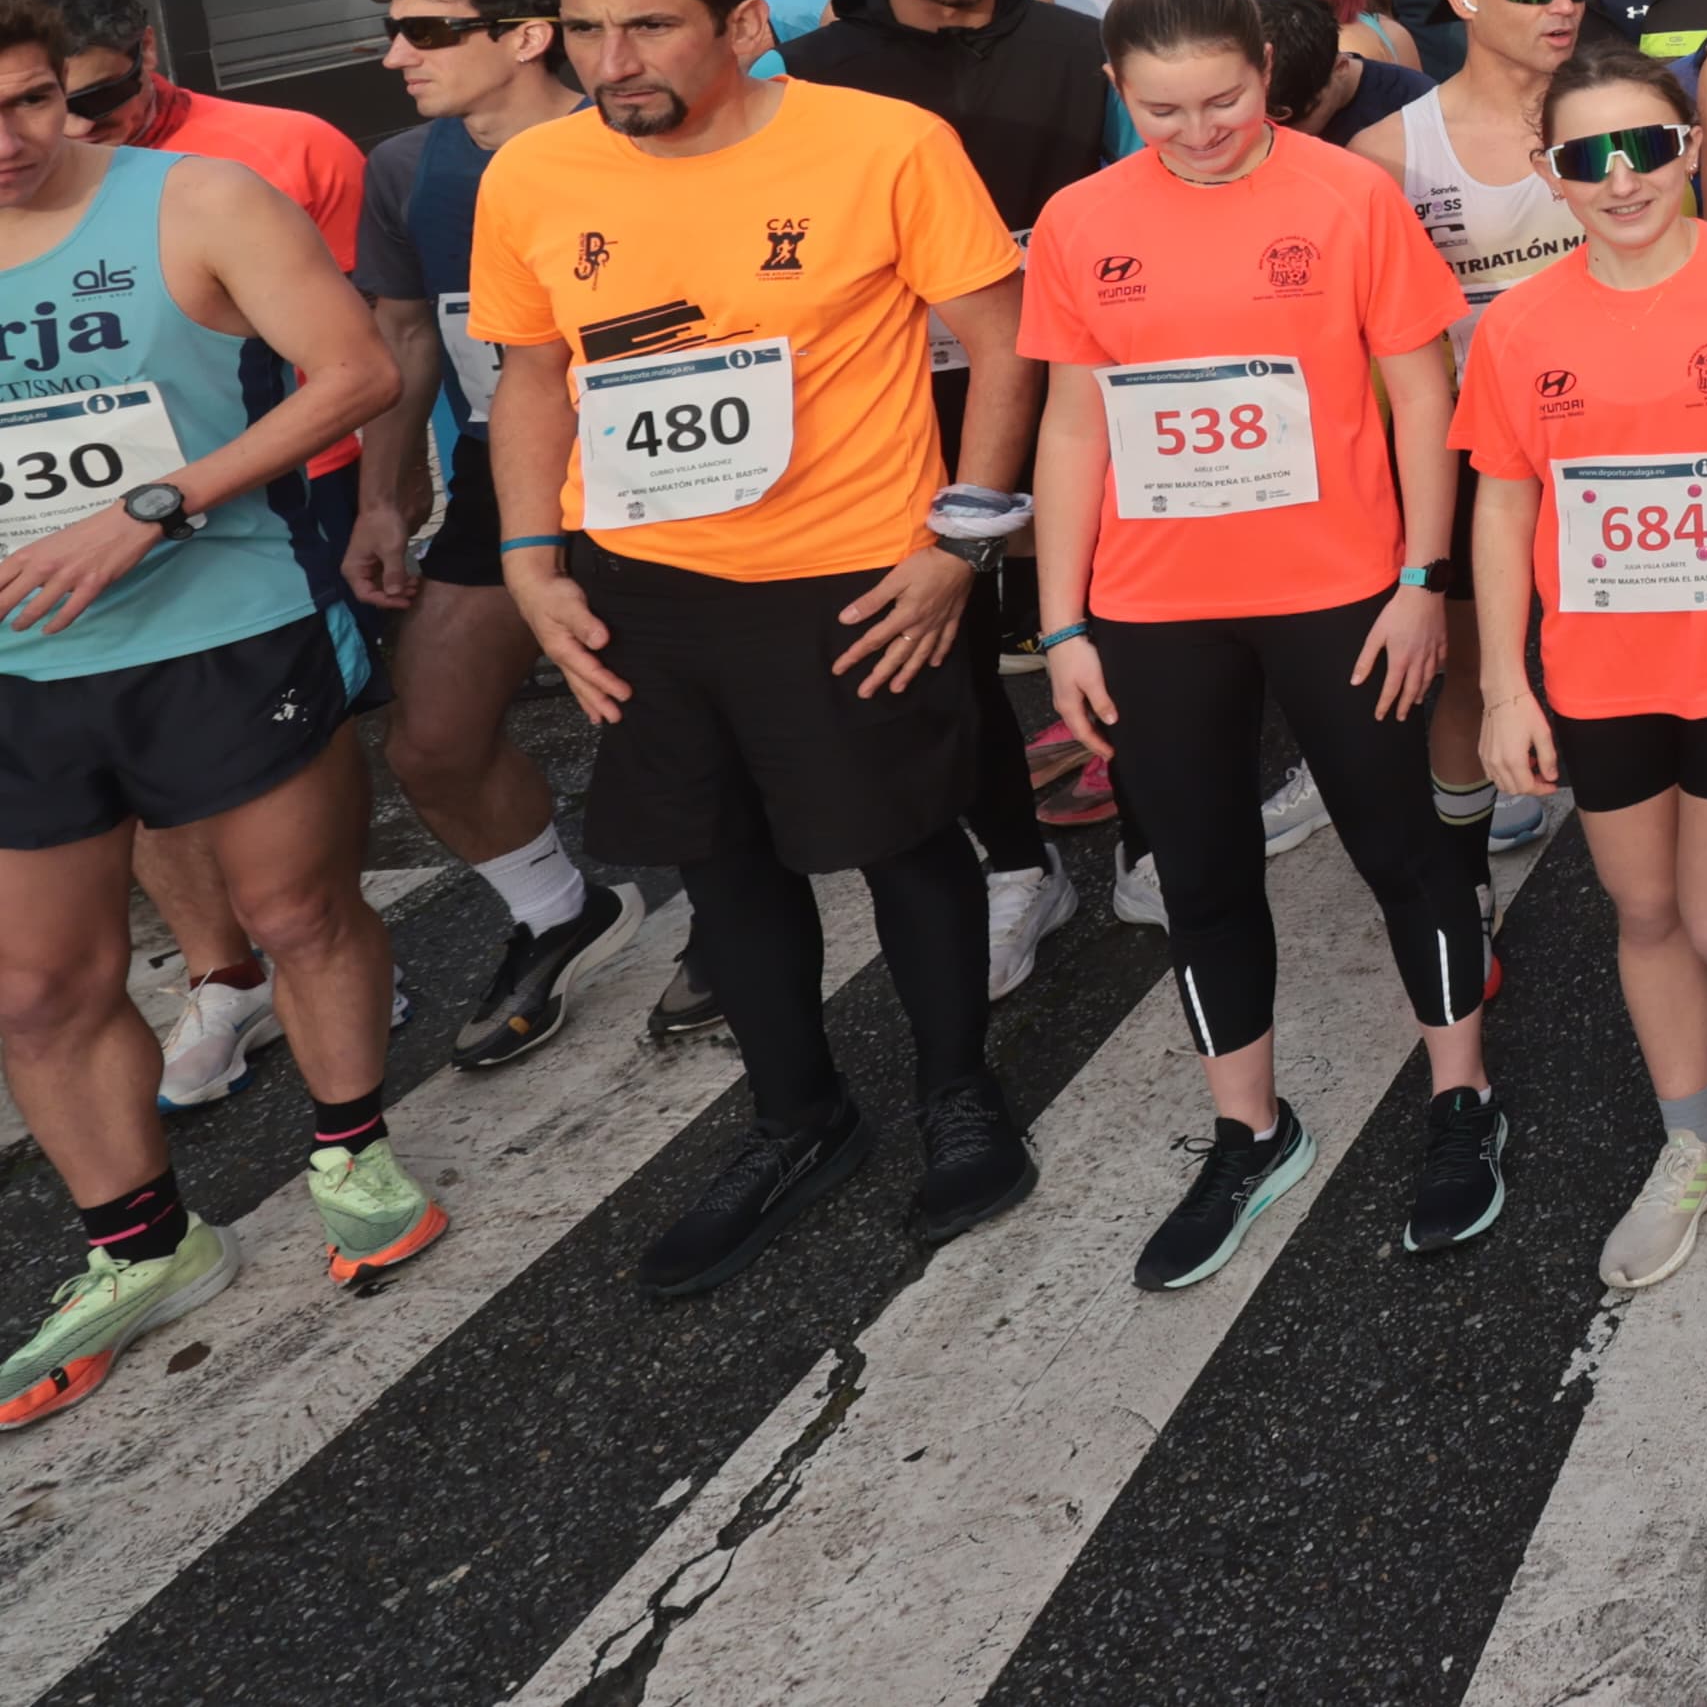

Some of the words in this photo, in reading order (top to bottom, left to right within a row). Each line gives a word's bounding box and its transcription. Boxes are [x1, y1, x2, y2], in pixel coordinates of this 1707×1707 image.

[766, 218, 811, 231] CAC
[1456, 238, 1558, 274] TRIATLÓN
[72, 259, 136, 292] als
[626, 396, 750, 457] 480
[1154, 403, 1268, 456] 538
[649, 479, 693, 494] MARATÓN
[694, 475, 721, 486] PEÑA
[722, 473, 734, 481] EL
[735, 467, 768, 479] BASTÓN
[676, 464, 697, 473] VILLA
[1176, 479, 1213, 489] MARATÓN
[1215, 477, 1239, 486] PEÑA
[1254, 470, 1291, 482] BASTÓN
[1600, 577, 1616, 585] MINI
[1618, 576, 1657, 585] MARATÓN
[1658, 575, 1680, 583] PEÑA
